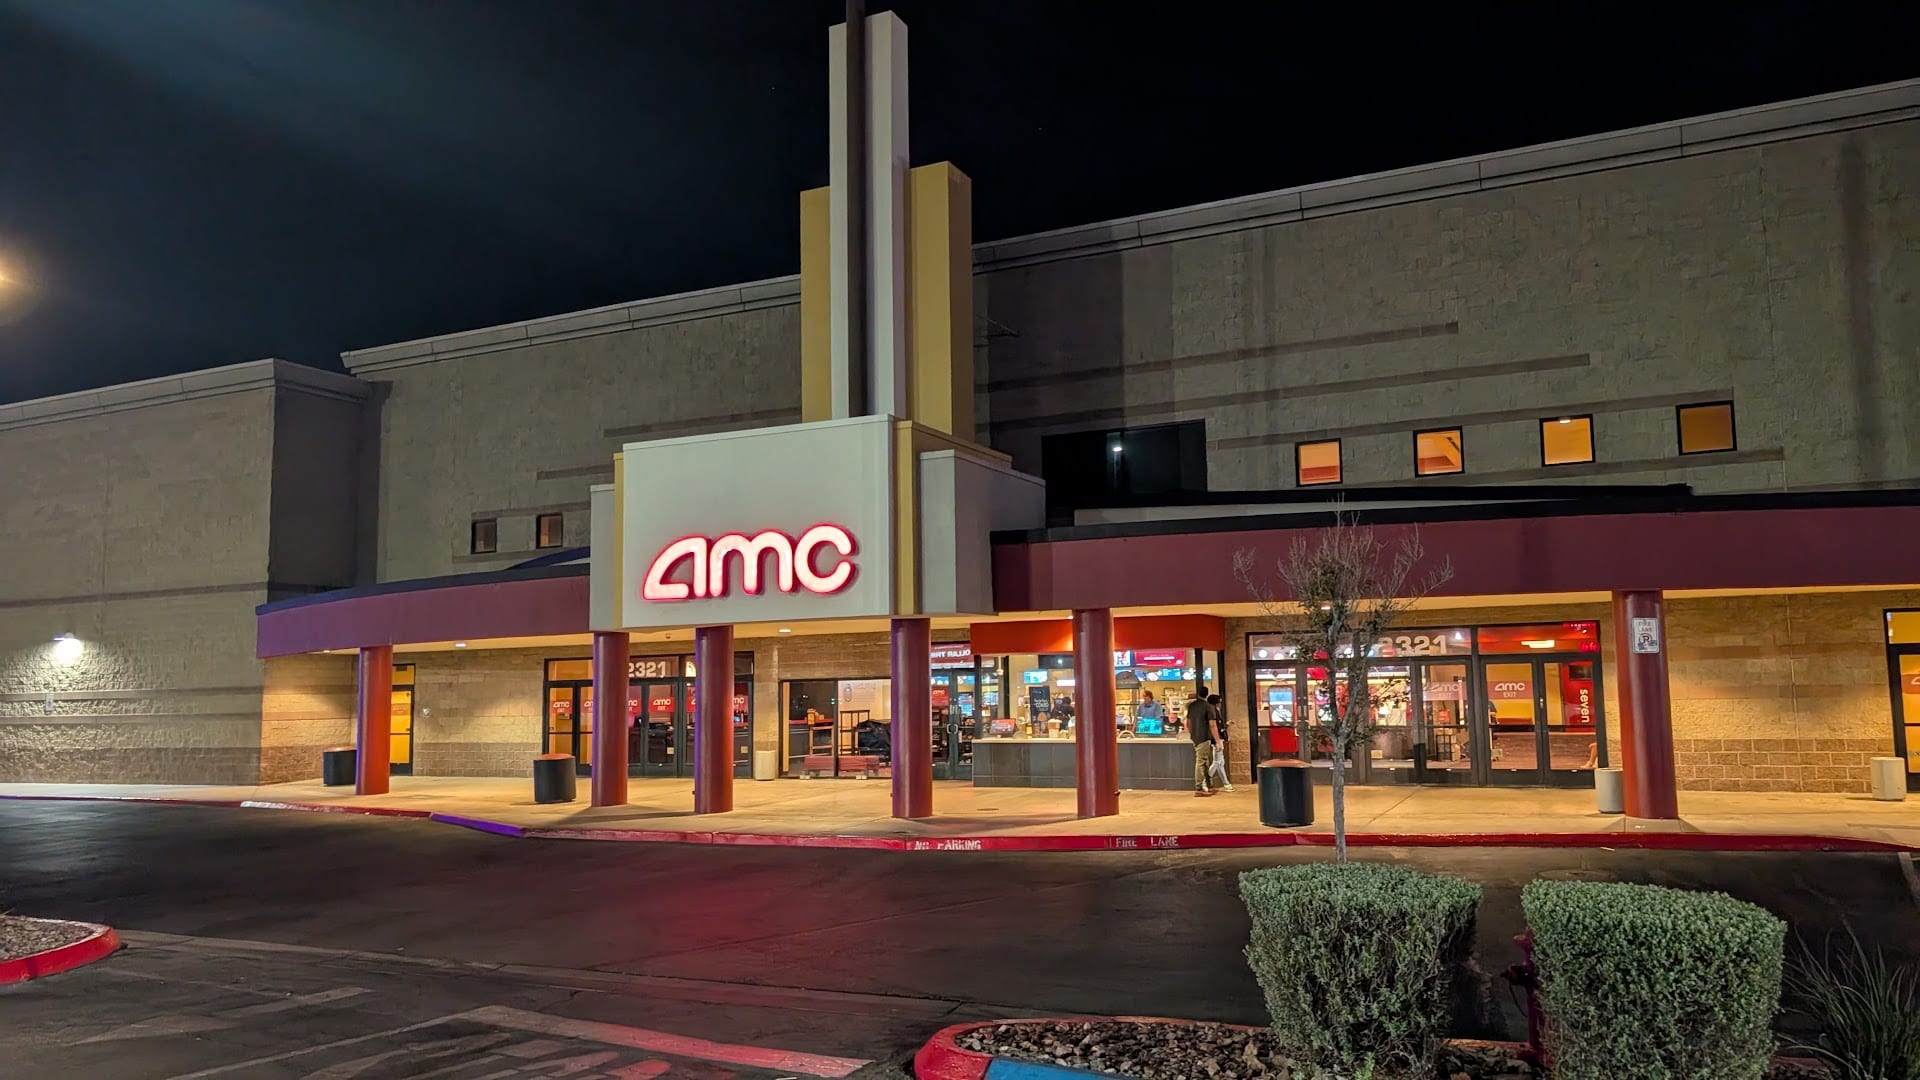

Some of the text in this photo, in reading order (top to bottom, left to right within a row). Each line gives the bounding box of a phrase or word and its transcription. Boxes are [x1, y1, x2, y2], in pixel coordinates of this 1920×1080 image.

[642, 522, 857, 600] amc
[1495, 682, 1526, 692] amc
[1579, 689, 1591, 723] seven
